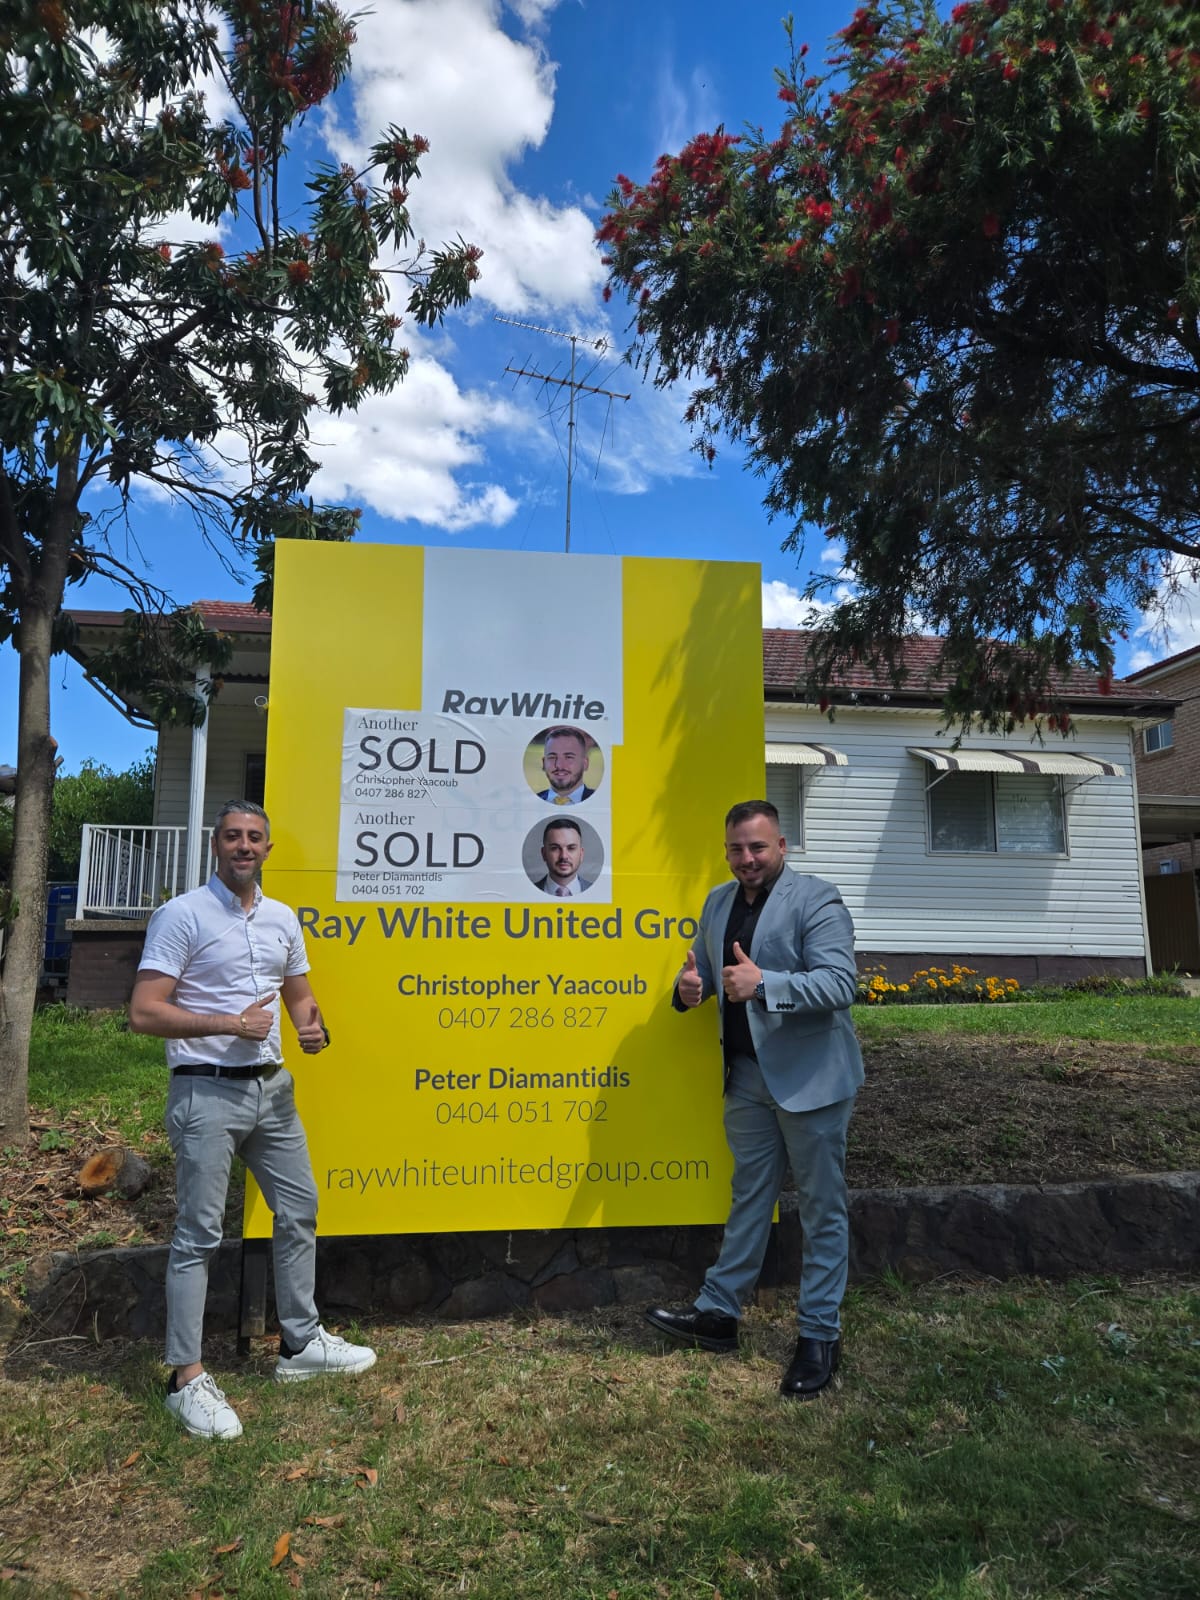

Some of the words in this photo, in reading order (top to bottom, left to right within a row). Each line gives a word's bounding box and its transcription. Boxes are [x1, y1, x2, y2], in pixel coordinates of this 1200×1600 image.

[358, 717, 419, 731] Another
[358, 735, 486, 774] SOLD
[355, 774, 415, 786] Christopher
[418, 776, 459, 787] Yaacoub
[354, 787, 382, 798] 0407
[385, 788, 405, 798] 286
[407, 789, 428, 799] 827
[354, 811, 415, 825] Another
[354, 831, 485, 867] SOLD
[352, 871, 380, 881] Peter
[382, 871, 443, 882] Diamantidis
[352, 885, 379, 895] 0404
[381, 885, 402, 895] 051
[405, 885, 425, 895] 702
[297, 906, 367, 946] Ray
[376, 907, 492, 940] White
[503, 908, 623, 939] United
[634, 908, 699, 940] Gro
[397, 974, 540, 1000] Christopher
[546, 974, 648, 996] Yaacoub
[438, 1007, 501, 1029] 0407
[509, 1007, 554, 1029] 286
[563, 1006, 608, 1029] 827
[415, 1068, 482, 1090] Peter
[488, 1066, 631, 1089] Diamantidis
[436, 1102, 499, 1125] 0404
[507, 1101, 553, 1123] 051
[563, 1100, 608, 1123] 702
[326, 1156, 710, 1195] raywhiteunitedgroup.com
